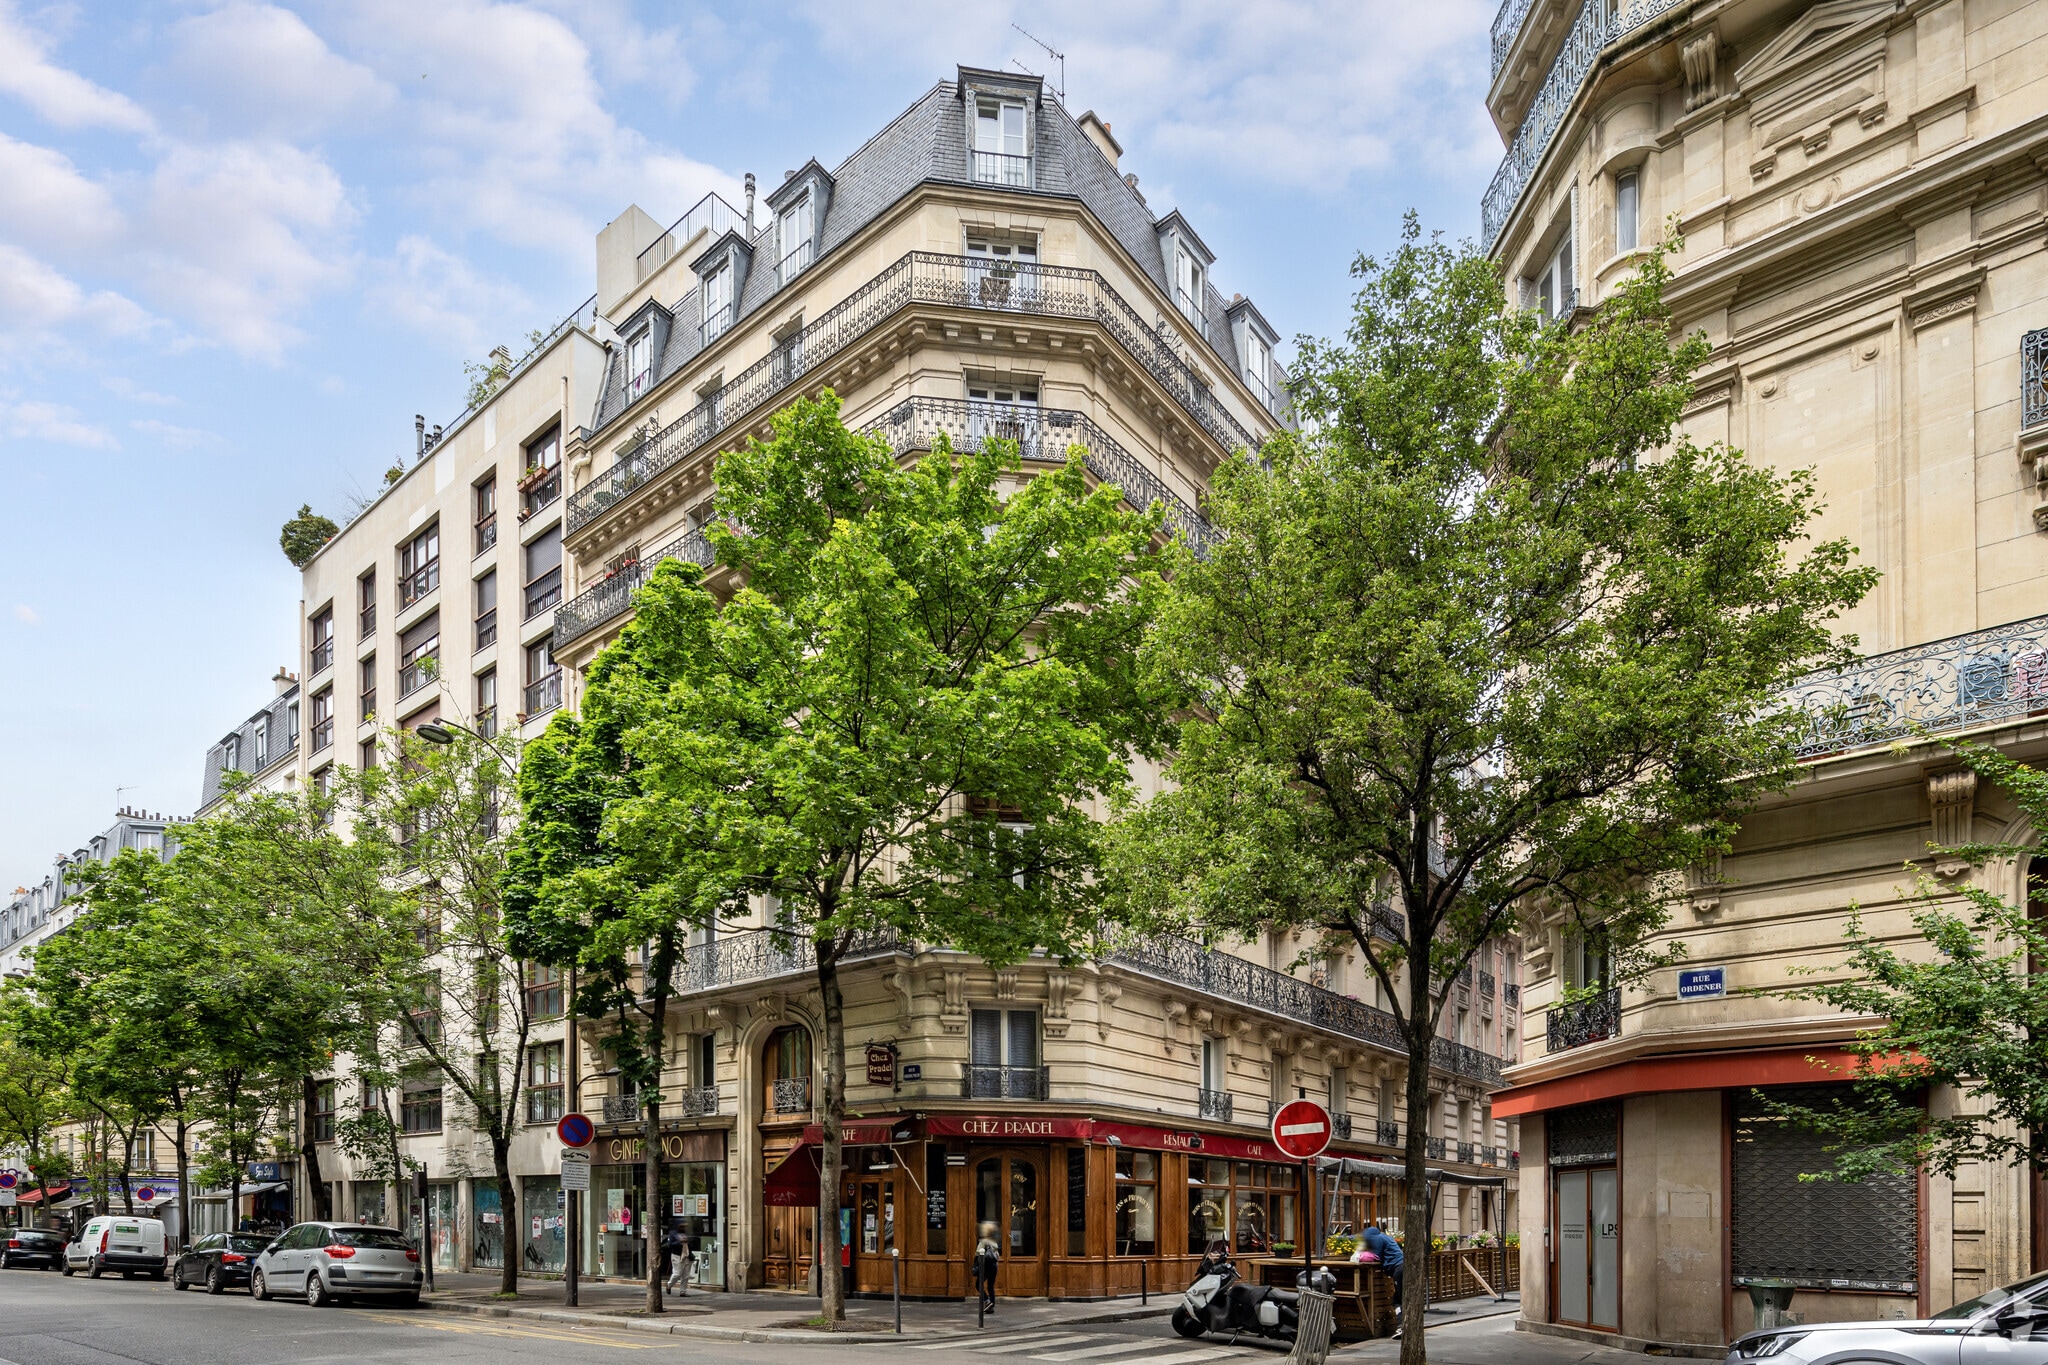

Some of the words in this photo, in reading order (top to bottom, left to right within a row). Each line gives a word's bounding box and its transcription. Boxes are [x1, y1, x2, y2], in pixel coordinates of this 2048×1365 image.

[1692, 975, 1710, 983] RUE
[1681, 983, 1722, 993] ORDENER
[870, 1053, 888, 1062] Chez
[869, 1063, 893, 1073] Pradel
[962, 1120, 999, 1134] CHEZ
[1004, 1121, 1056, 1134] PRADEL
[842, 1129, 856, 1141] AFE
[1163, 1134, 1205, 1149] RESTAUT
[610, 1137, 640, 1161] GINA
